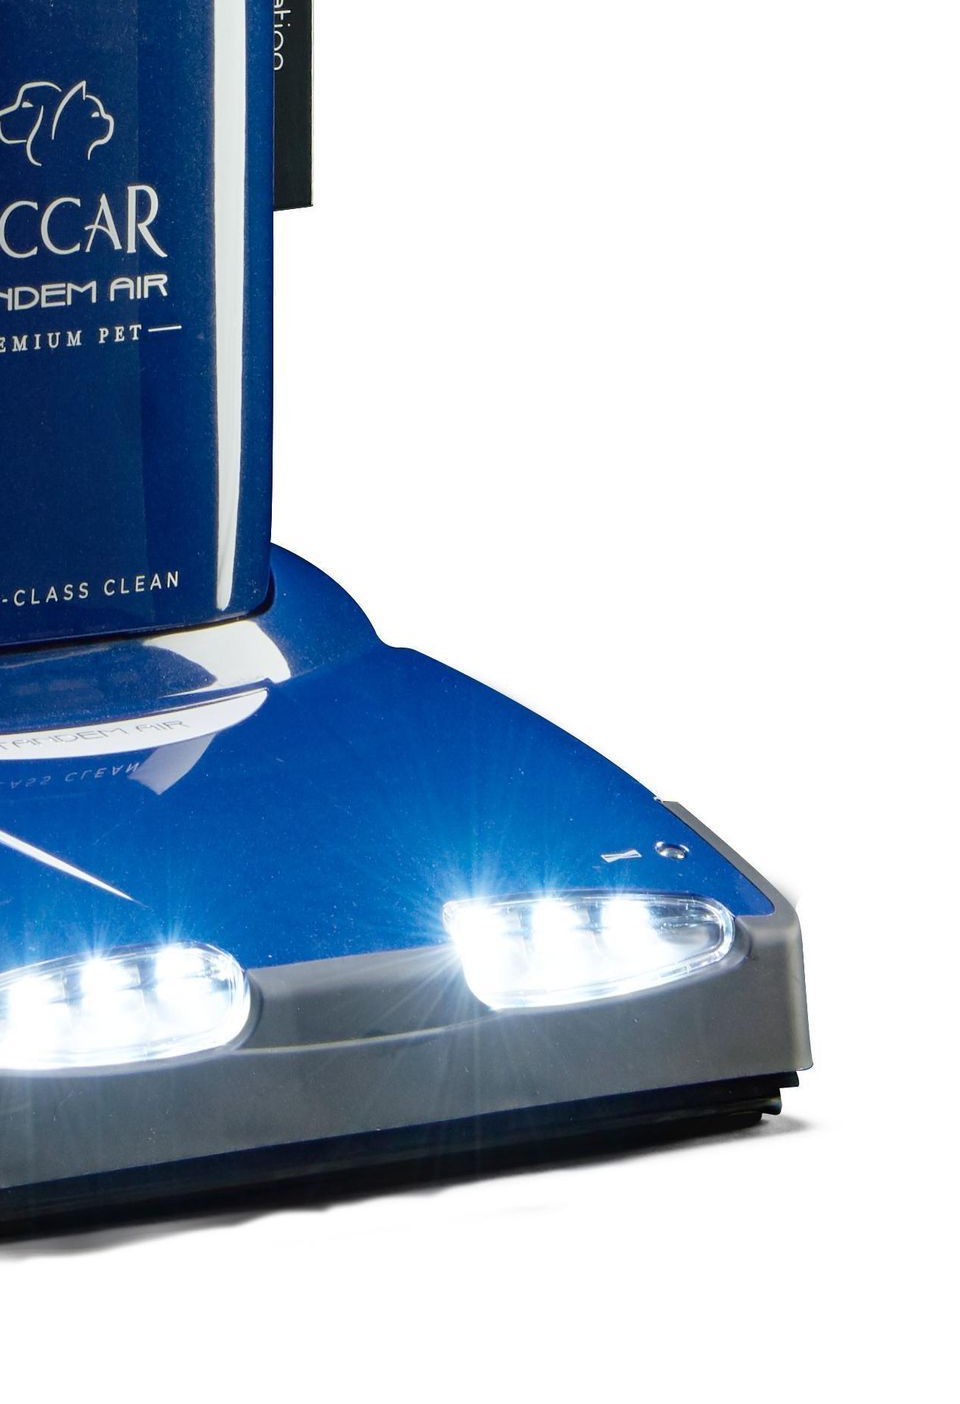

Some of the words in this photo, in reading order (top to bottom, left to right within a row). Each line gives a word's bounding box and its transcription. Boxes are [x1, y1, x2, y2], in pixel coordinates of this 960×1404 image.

[109, 273, 169, 302] AIR
[98, 323, 143, 344] PET
[102, 570, 181, 597] CLEAN
[135, 719, 190, 734] AIR
